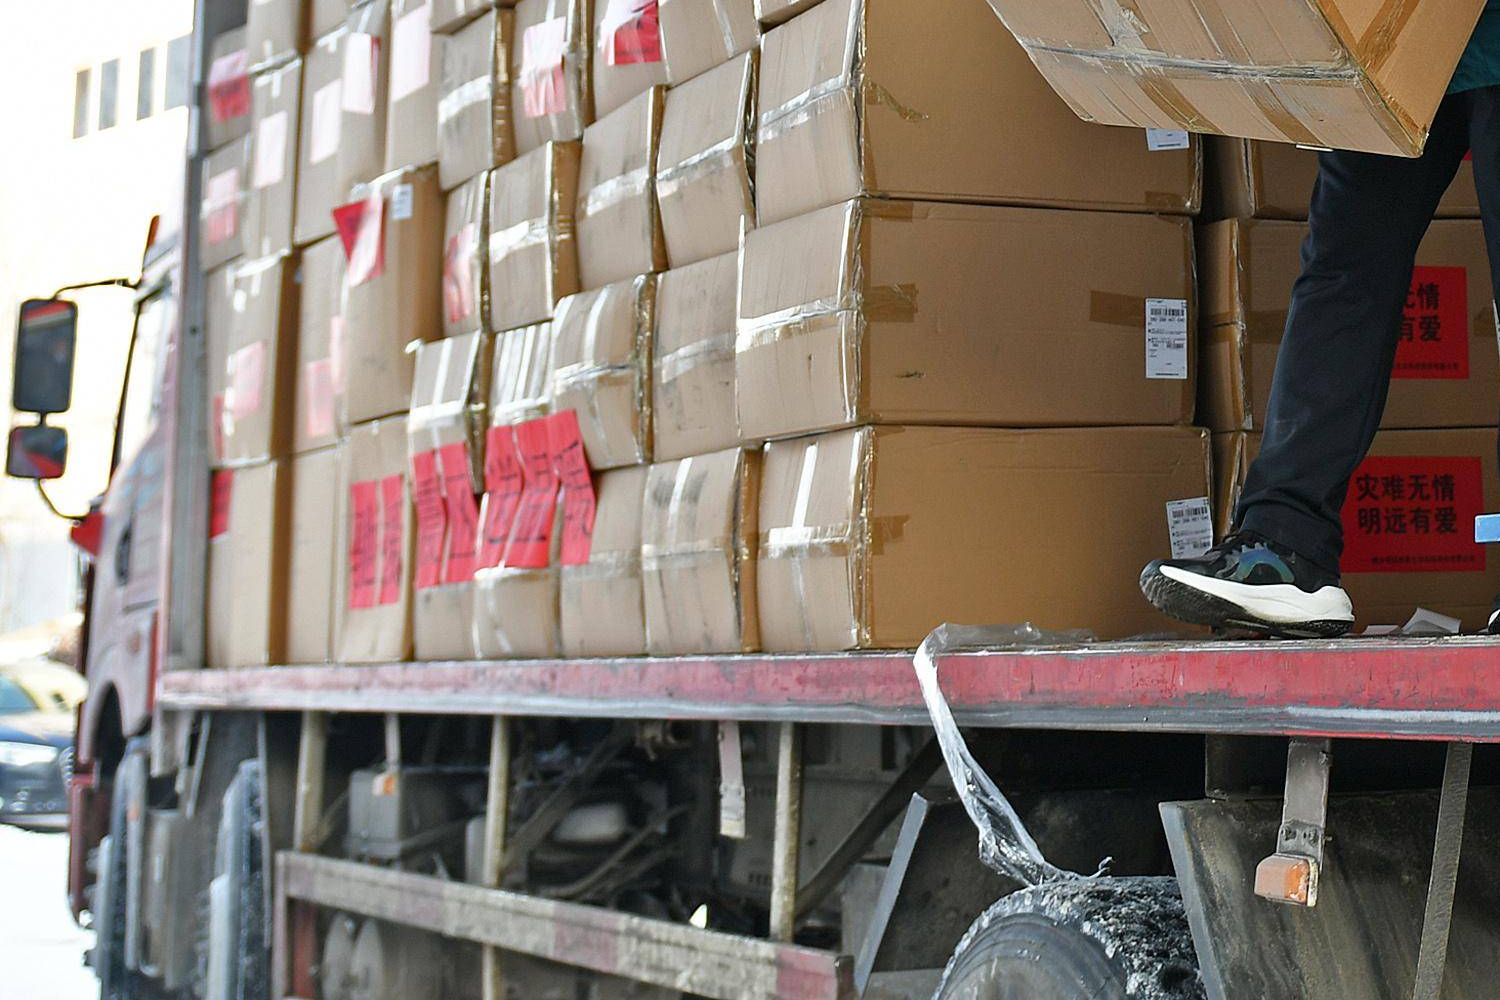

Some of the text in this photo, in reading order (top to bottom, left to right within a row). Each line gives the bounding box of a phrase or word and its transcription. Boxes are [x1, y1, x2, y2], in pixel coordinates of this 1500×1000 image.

[1357, 473, 1456, 501] 灾难无情
[1358, 507, 1457, 535] 明远有爱
